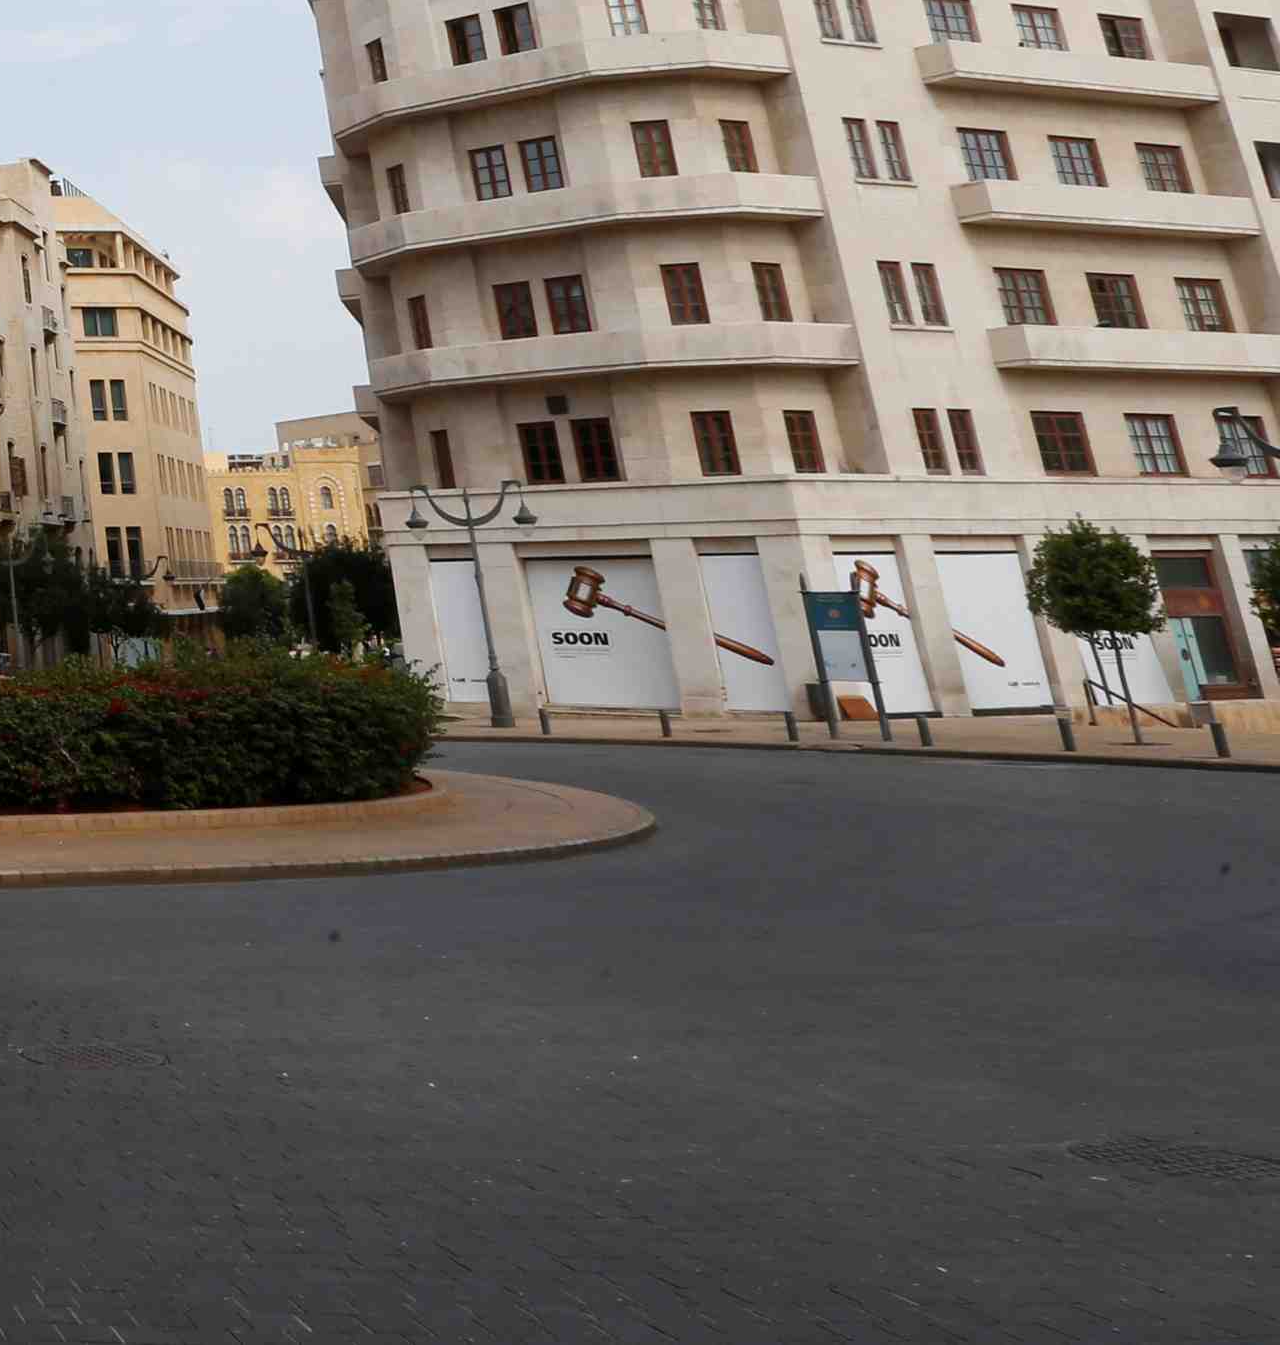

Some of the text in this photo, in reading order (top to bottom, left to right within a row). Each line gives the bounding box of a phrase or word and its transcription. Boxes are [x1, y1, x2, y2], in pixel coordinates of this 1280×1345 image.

[551, 632, 610, 646] SOON
[867, 633, 901, 647] OON
[1093, 637, 1135, 650] SOON
